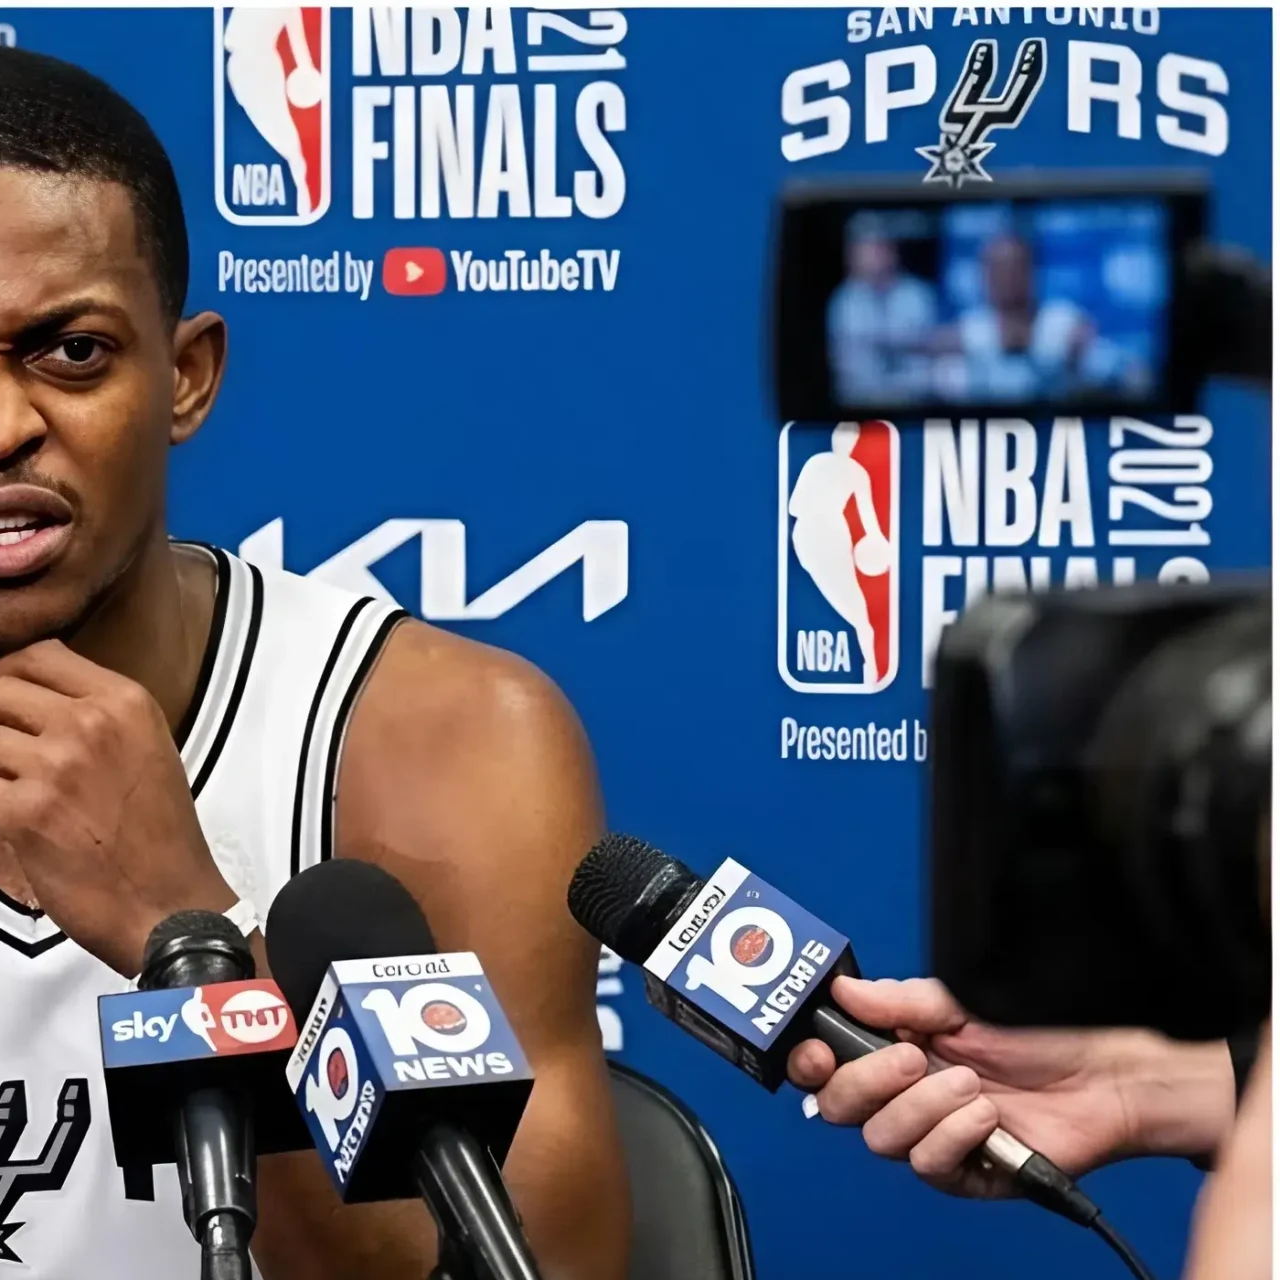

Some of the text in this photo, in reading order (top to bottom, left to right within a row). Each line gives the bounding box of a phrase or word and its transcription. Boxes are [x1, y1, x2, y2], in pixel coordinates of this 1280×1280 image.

[352, 81, 627, 219] FINALS
[232, 164, 286, 207] NBA
[218, 250, 339, 293] Presented
[344, 251, 374, 301] by
[922, 416, 1096, 548] NBA
[1108, 414, 1214, 546] 2021
[796, 630, 851, 672] NBA
[781, 716, 907, 761] Presented
[111, 1011, 179, 1043] sky
[393, 1052, 514, 1082] NEWS
